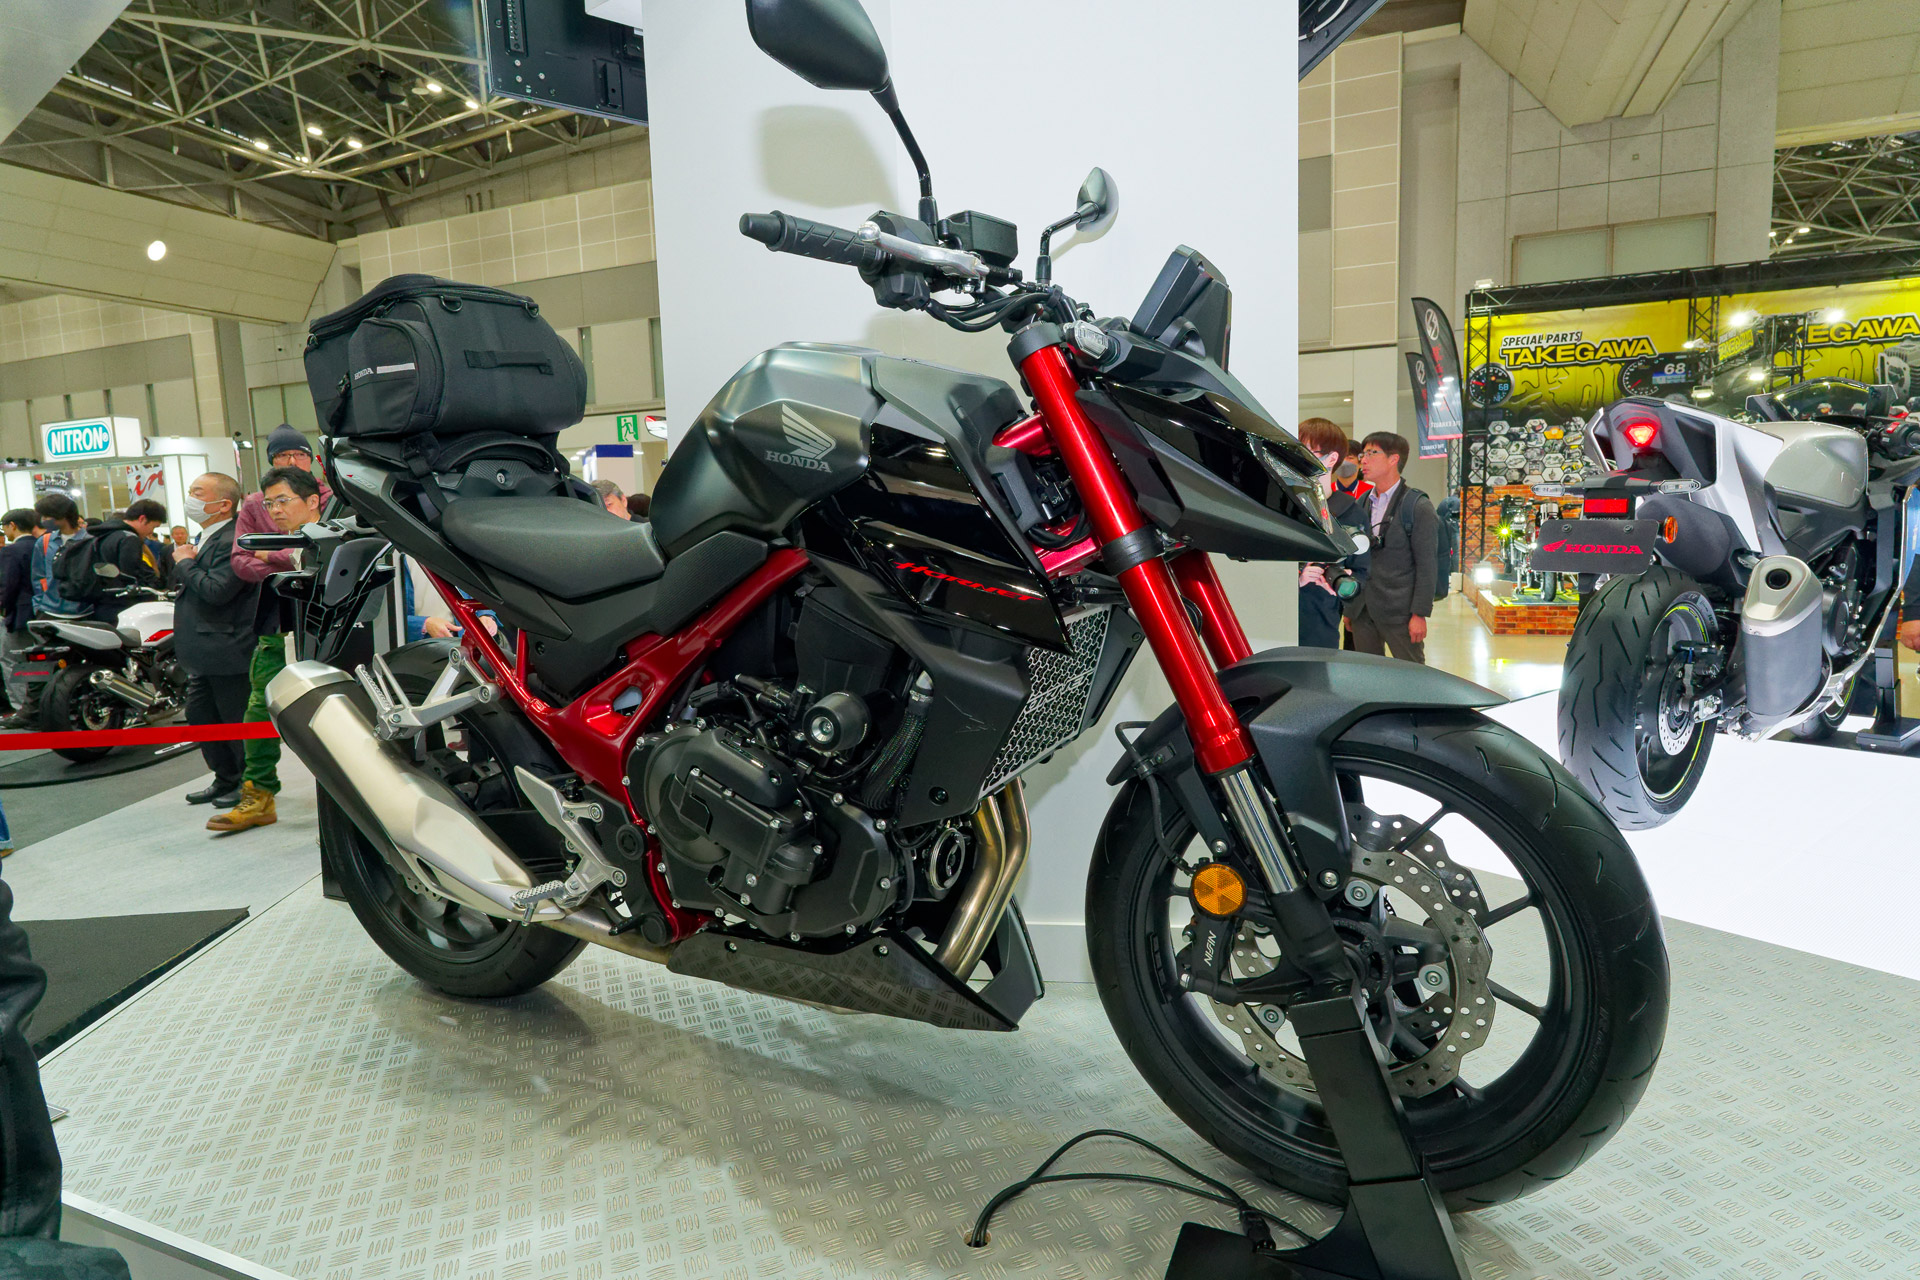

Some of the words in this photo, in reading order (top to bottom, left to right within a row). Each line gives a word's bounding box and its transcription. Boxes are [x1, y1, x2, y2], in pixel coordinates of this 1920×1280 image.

[1502, 334, 1543, 347] SPECIAL
[1545, 331, 1582, 344] PARTS
[1790, 316, 1920, 344] EGAWA
[1502, 337, 1655, 366] TAKEGAWA
[354, 367, 374, 381] HONDA
[1664, 362, 1686, 375] 68
[51, 426, 103, 454] NITRON
[765, 450, 833, 474] HONDA
[1565, 543, 1644, 555] HONDA
[1203, 930, 1217, 967] NISSIN
